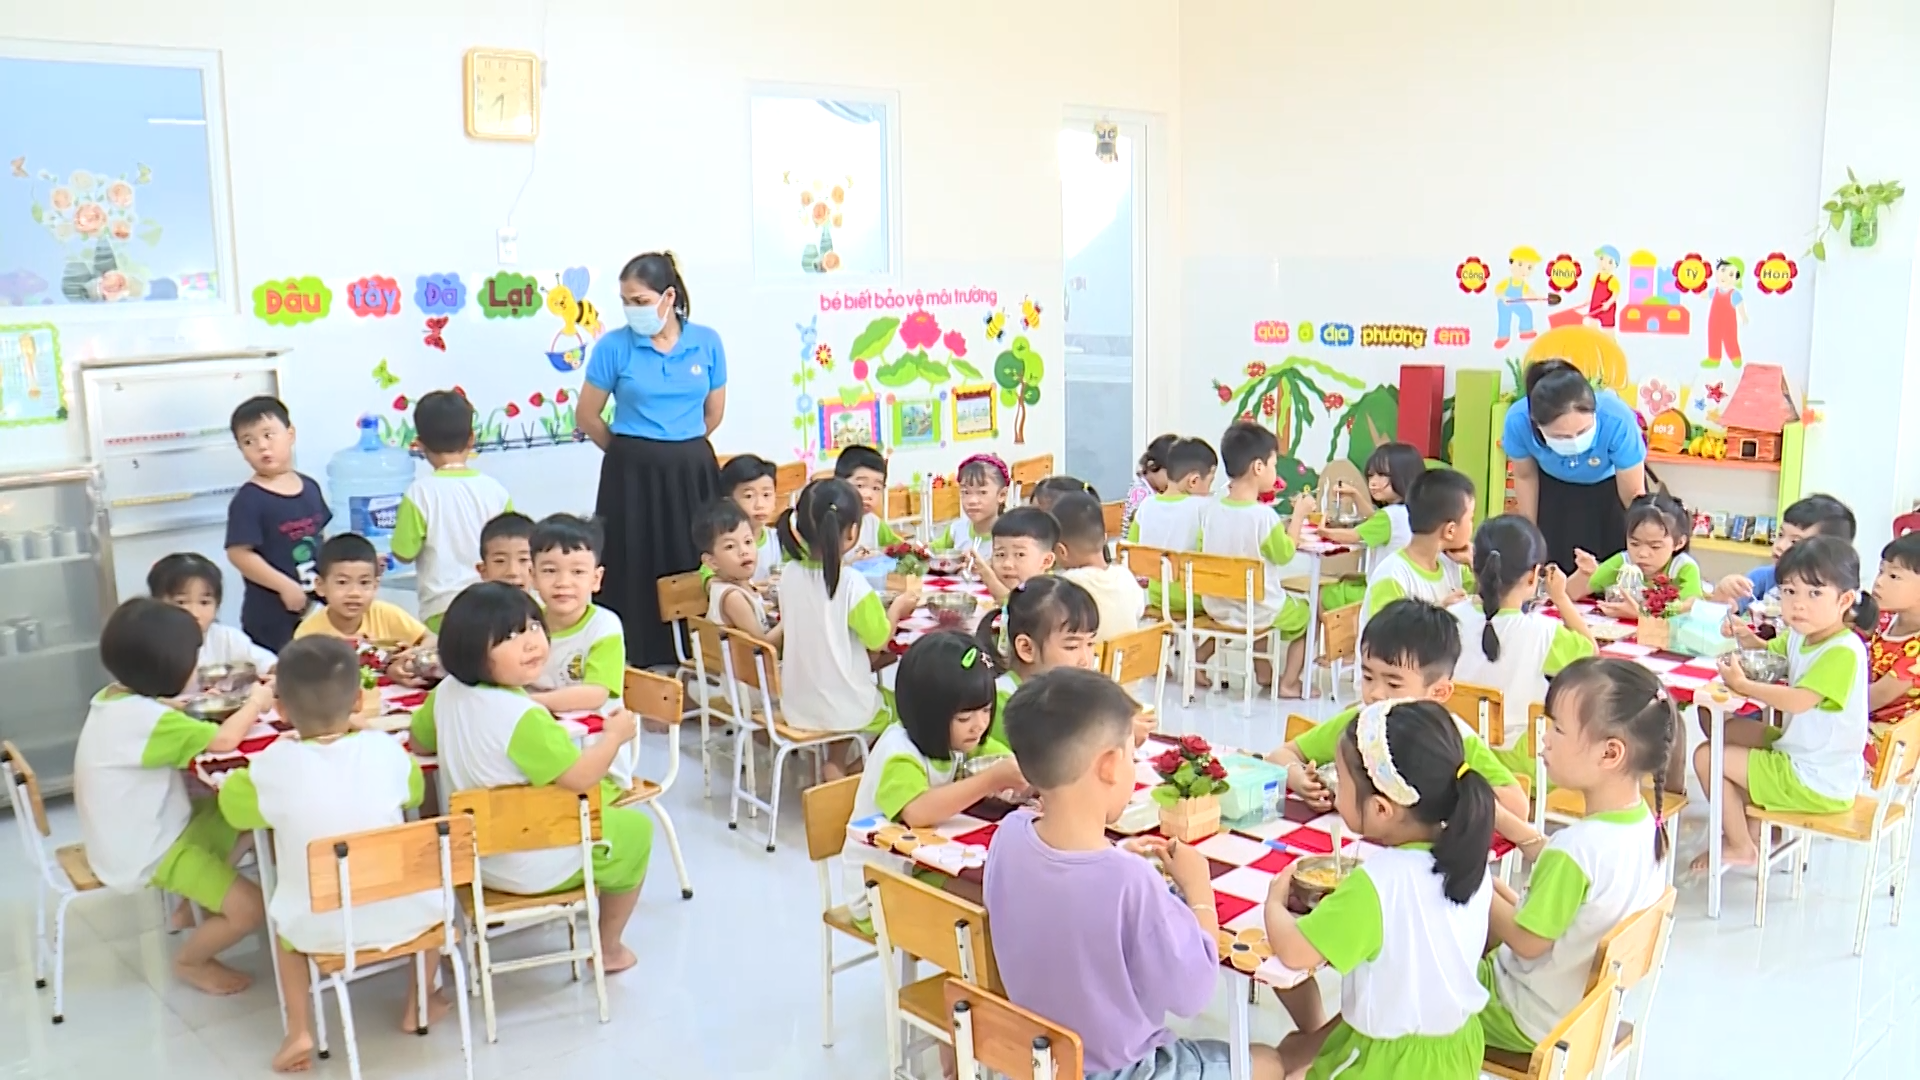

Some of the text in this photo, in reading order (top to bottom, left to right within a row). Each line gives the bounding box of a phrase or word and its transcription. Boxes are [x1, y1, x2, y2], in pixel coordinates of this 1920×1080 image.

[265, 278, 534, 315] Dâu tây Đà Lạt
[819, 290, 843, 311] bé
[844, 288, 872, 309] biết
[874, 287, 905, 309] bảo
[926, 288, 952, 305] môi
[954, 283, 998, 308] trường
[1438, 329, 1466, 344] em
[1667, 424, 1675, 436] 2
